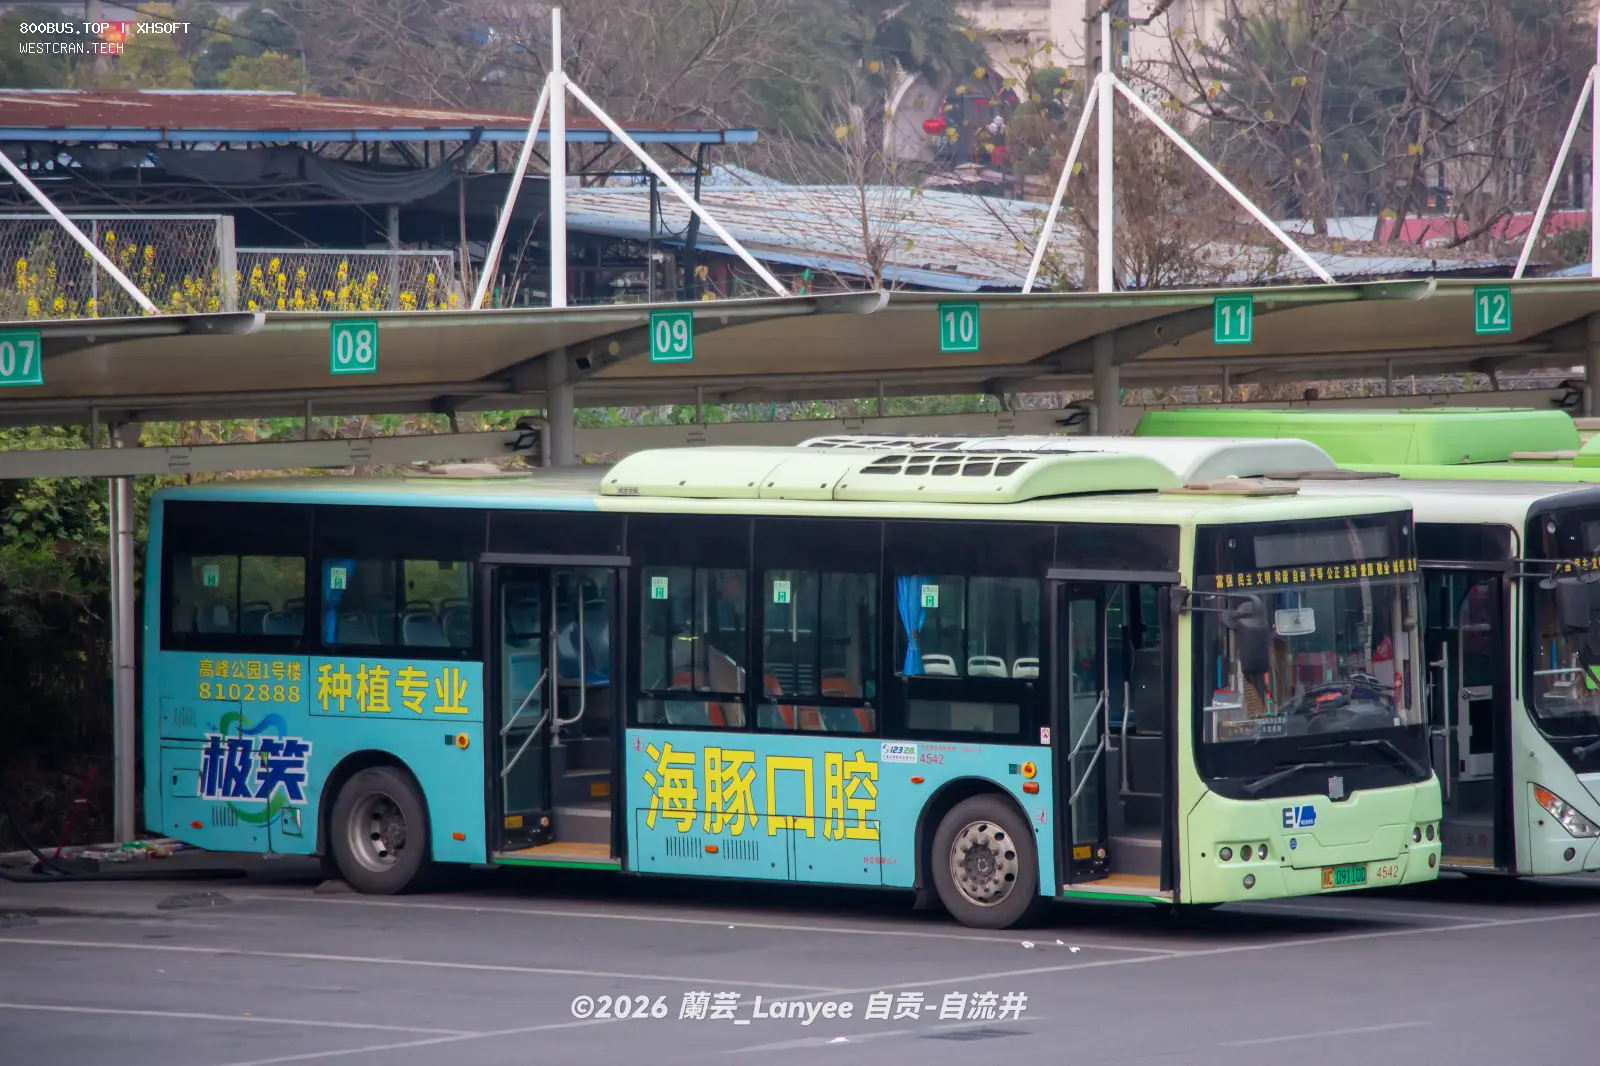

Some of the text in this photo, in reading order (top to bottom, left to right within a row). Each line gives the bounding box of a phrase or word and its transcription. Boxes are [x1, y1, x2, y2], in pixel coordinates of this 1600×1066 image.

[1221, 305, 1246, 336] 11
[1479, 294, 1506, 325] 12
[656, 319, 688, 353] 09
[945, 311, 974, 343] 10
[0, 340, 35, 377] 07
[337, 329, 372, 364] 08
[1215, 574, 1233, 589] 富强
[1237, 572, 1253, 587] 民主
[1256, 570, 1271, 585] 文明
[1274, 569, 1289, 583] 和谐
[1292, 568, 1306, 583] 自由
[1309, 567, 1323, 581] 平等
[1326, 566, 1341, 580] 公正
[1343, 564, 1358, 578] 法治
[1360, 562, 1374, 577] 爱国
[1376, 561, 1390, 575] 敬业
[1392, 559, 1405, 573] 诚信
[199, 658, 301, 682] 高峰公园1号楼
[199, 682, 301, 703] 8102888
[317, 663, 470, 716] 种植专业
[890, 746, 915, 755] 12328
[920, 753, 945, 765] 4542
[643, 742, 880, 841] 海豚口腔
[1376, 865, 1399, 878] 4542
